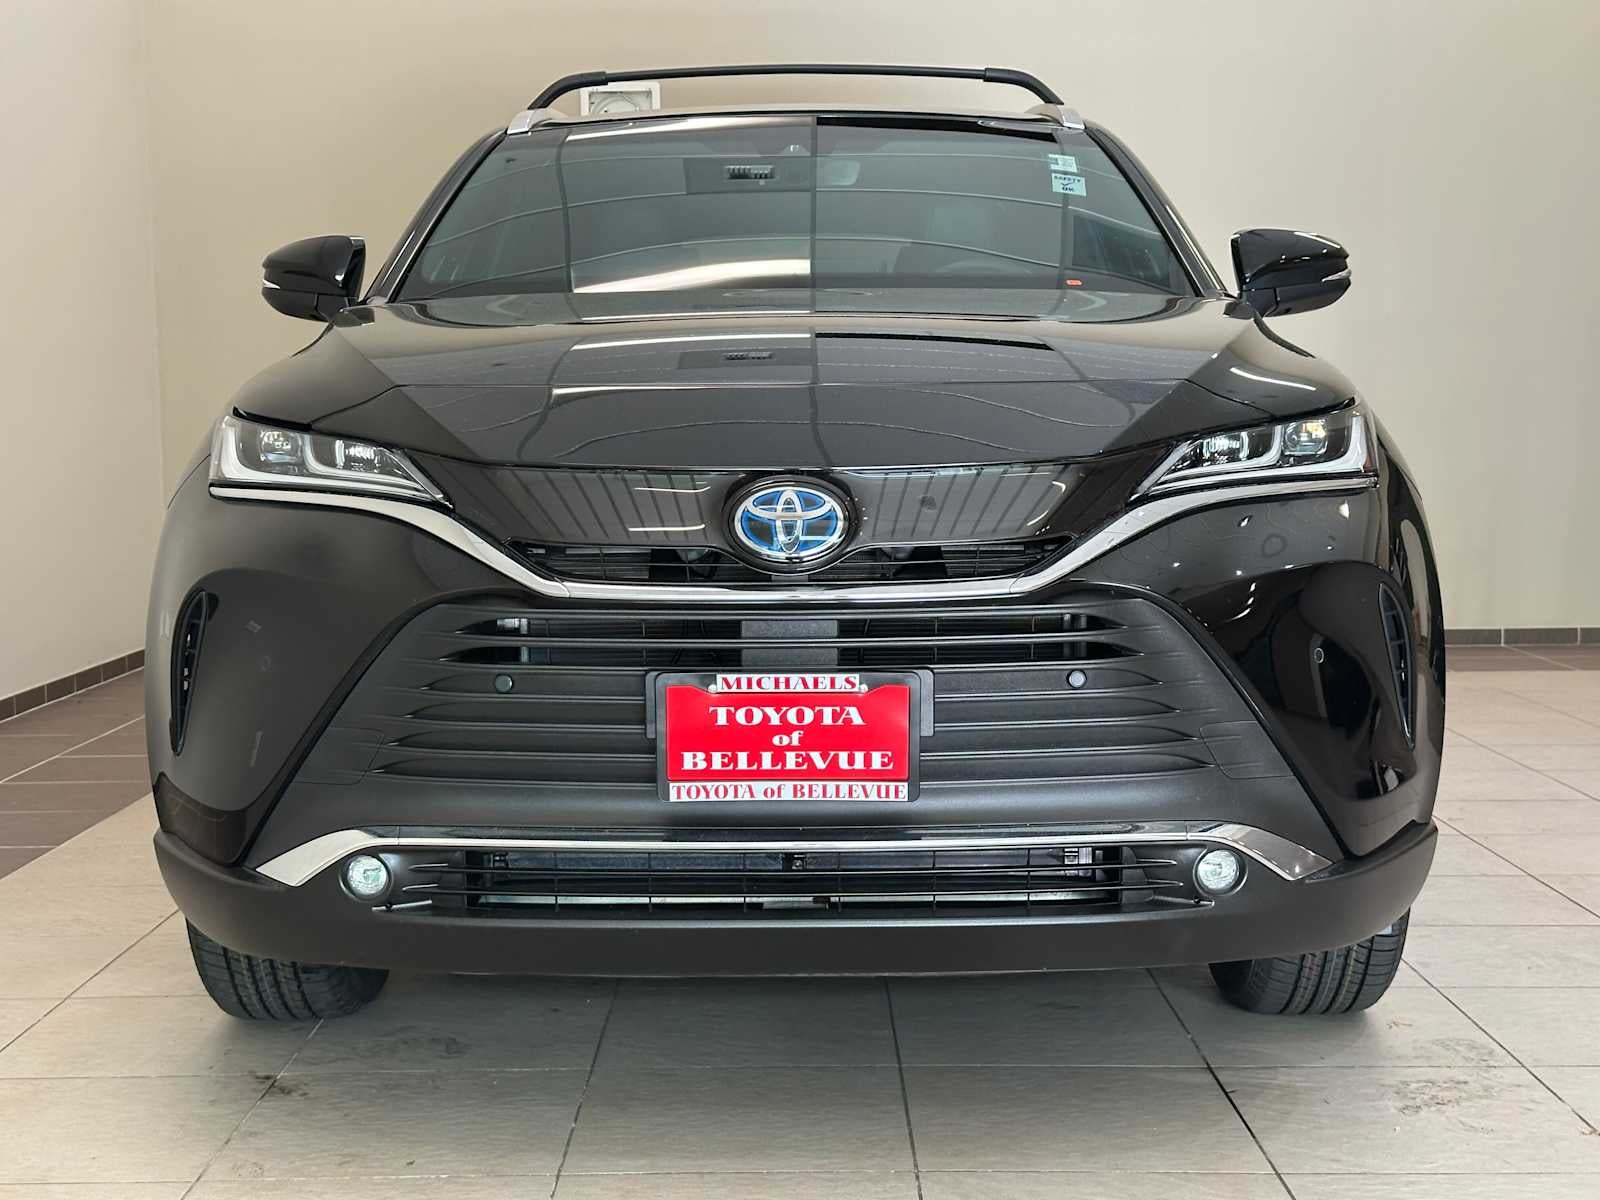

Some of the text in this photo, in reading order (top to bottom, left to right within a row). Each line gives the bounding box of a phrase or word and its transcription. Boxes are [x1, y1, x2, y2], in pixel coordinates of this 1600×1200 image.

[720, 675, 858, 690] MICHAELS
[708, 706, 866, 726] TOYOTA
[771, 730, 804, 747] of
[680, 751, 894, 770] BELLEVUE
[671, 783, 907, 800] TOYOTA of BELLEVUE
